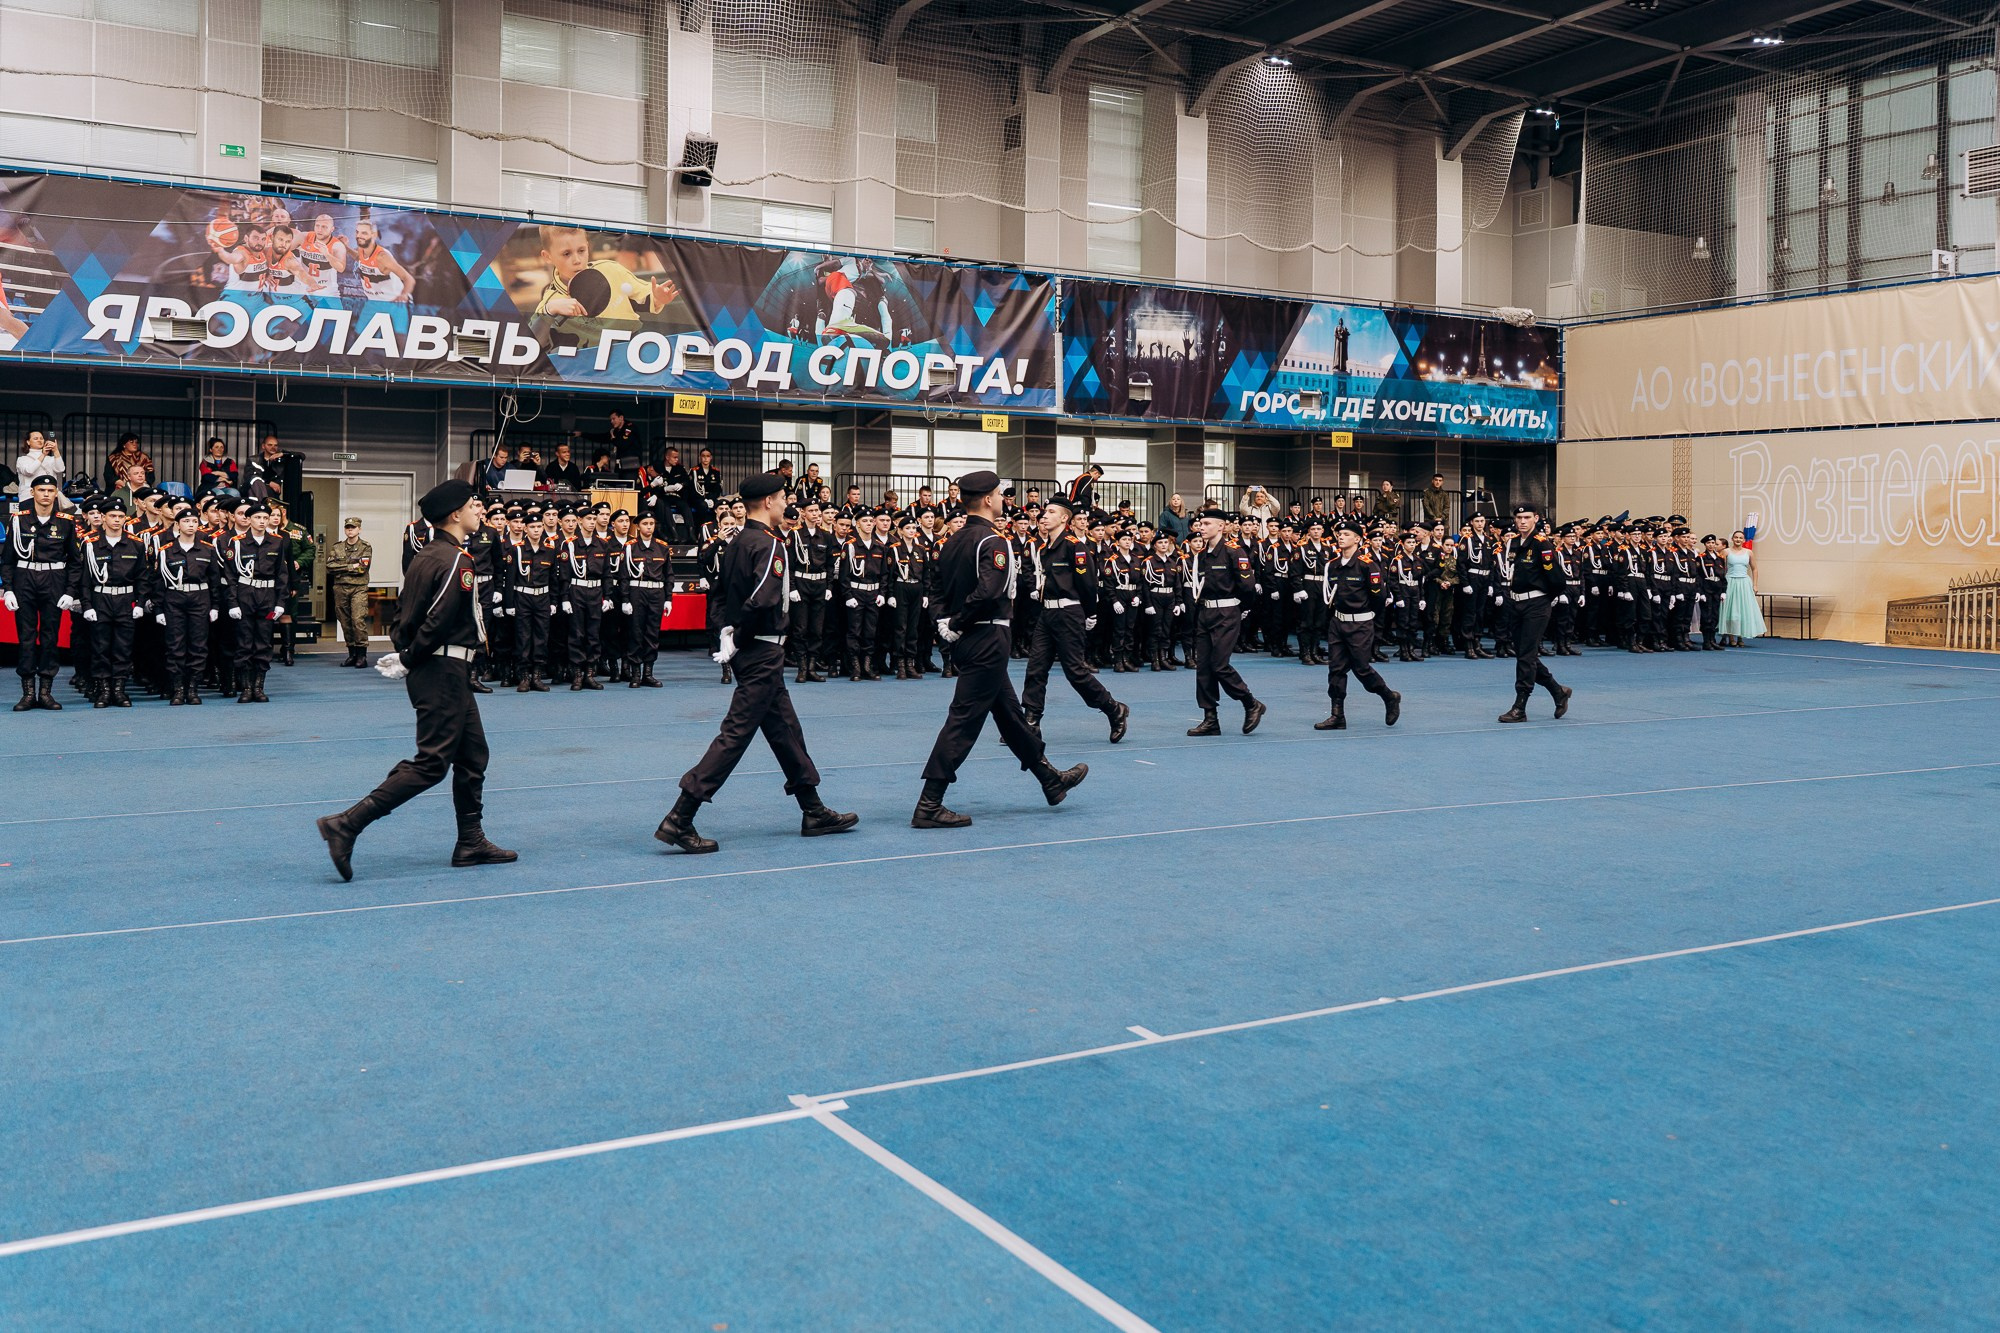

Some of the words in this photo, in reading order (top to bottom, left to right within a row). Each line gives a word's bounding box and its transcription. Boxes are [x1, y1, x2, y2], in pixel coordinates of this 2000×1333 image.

[594, 328, 794, 390] ГОРОД
[808, 345, 1029, 396] СПОРТА!
[679, 399, 696, 409] СЕКТОР
[1631, 366, 1673, 413] АО
[1333, 397, 1376, 422] ГДЕ
[1379, 399, 1482, 426] ХОЧЕТСЯ
